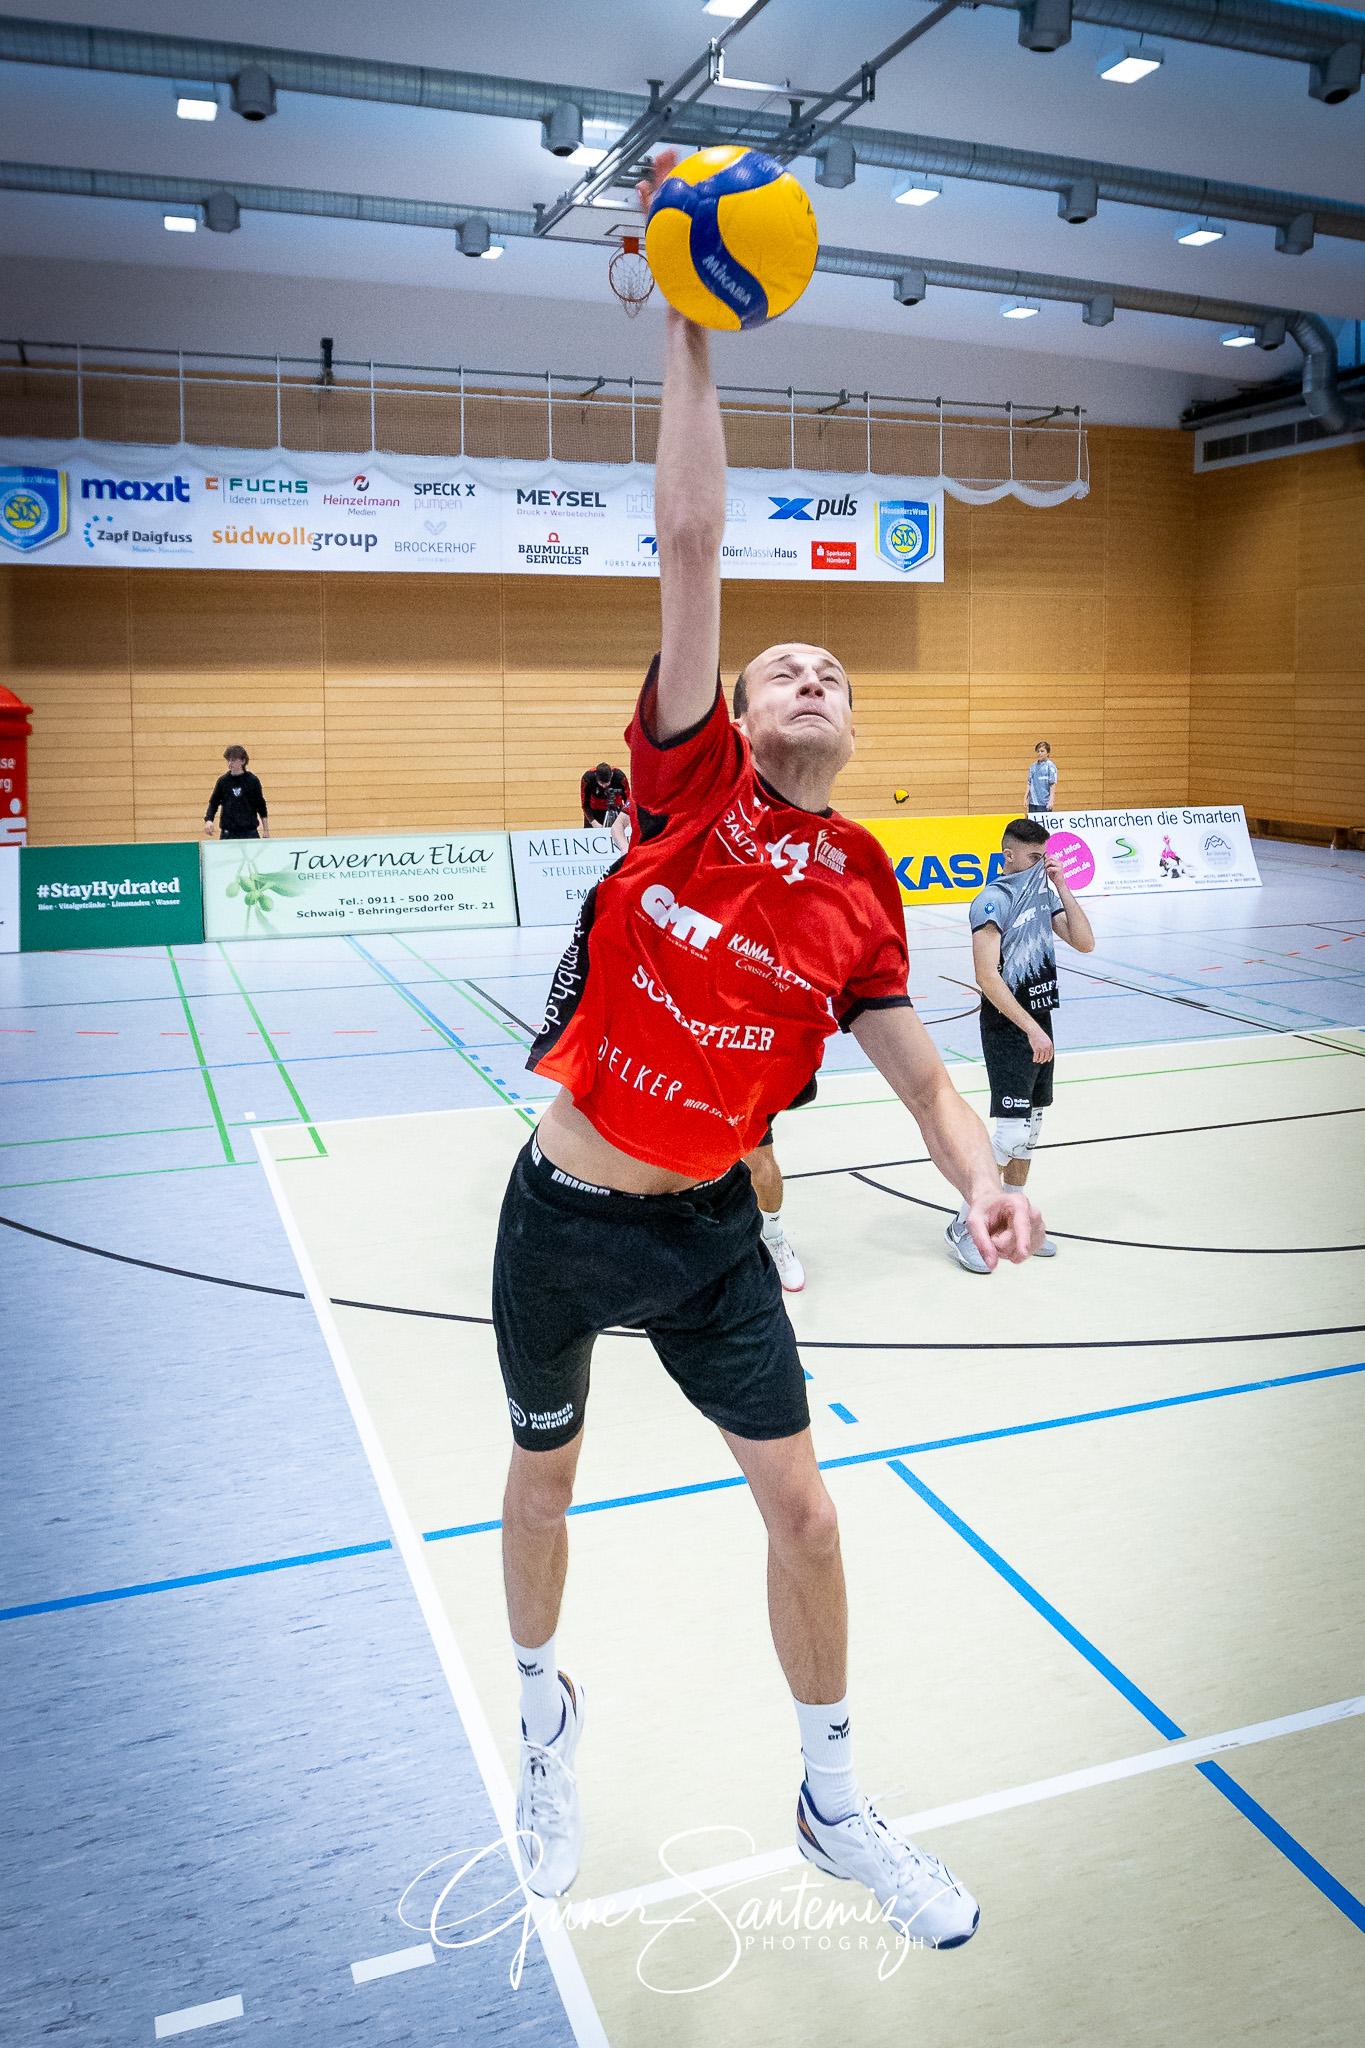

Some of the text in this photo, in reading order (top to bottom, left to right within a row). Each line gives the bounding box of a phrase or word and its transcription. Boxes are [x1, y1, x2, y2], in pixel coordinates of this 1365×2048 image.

[81, 476, 190, 503] maxit
[229, 478, 308, 493] FUCHS
[414, 483, 461, 496] SPECK
[229, 495, 309, 507] Ideen umsetzen
[323, 495, 400, 507] Heinzelmann
[414, 498, 462, 511] pumpen
[517, 489, 606, 508] MEYSEL
[347, 508, 376, 516] Medien
[517, 508, 540, 516] Druck
[550, 510, 606, 518] Werbetechnik
[97, 530, 193, 545] Zapf Daigfuss
[394, 542, 477, 553] BROCKERHOF
[826, 550, 852, 558] Sparkasse
[526, 555, 582, 564] SERVICES
[605, 559, 629, 568] FÜRST
[826, 557, 851, 565] Nürnberg
[1033, 810, 1241, 829] Hier schnarchen die Smarten
[1063, 842, 1082, 855] Infos
[289, 843, 495, 871] Taverna Elia
[297, 865, 488, 880] GREEK MEDITERRANEAN CUISINE
[890, 852, 1006, 891] KASA
[36, 877, 181, 901] #StayHydrated
[38, 898, 181, 911] Bier Vitalgetränke Limonaden Wasser
[339, 897, 364, 906] Tel.:
[367, 896, 396, 905] 0911
[408, 894, 430, 903] 500
[433, 893, 454, 902] 200
[296, 909, 346, 919] Schwaig
[358, 904, 455, 916] Behringersdorfer
[458, 902, 478, 911] Str.
[481, 901, 495, 909] 21
